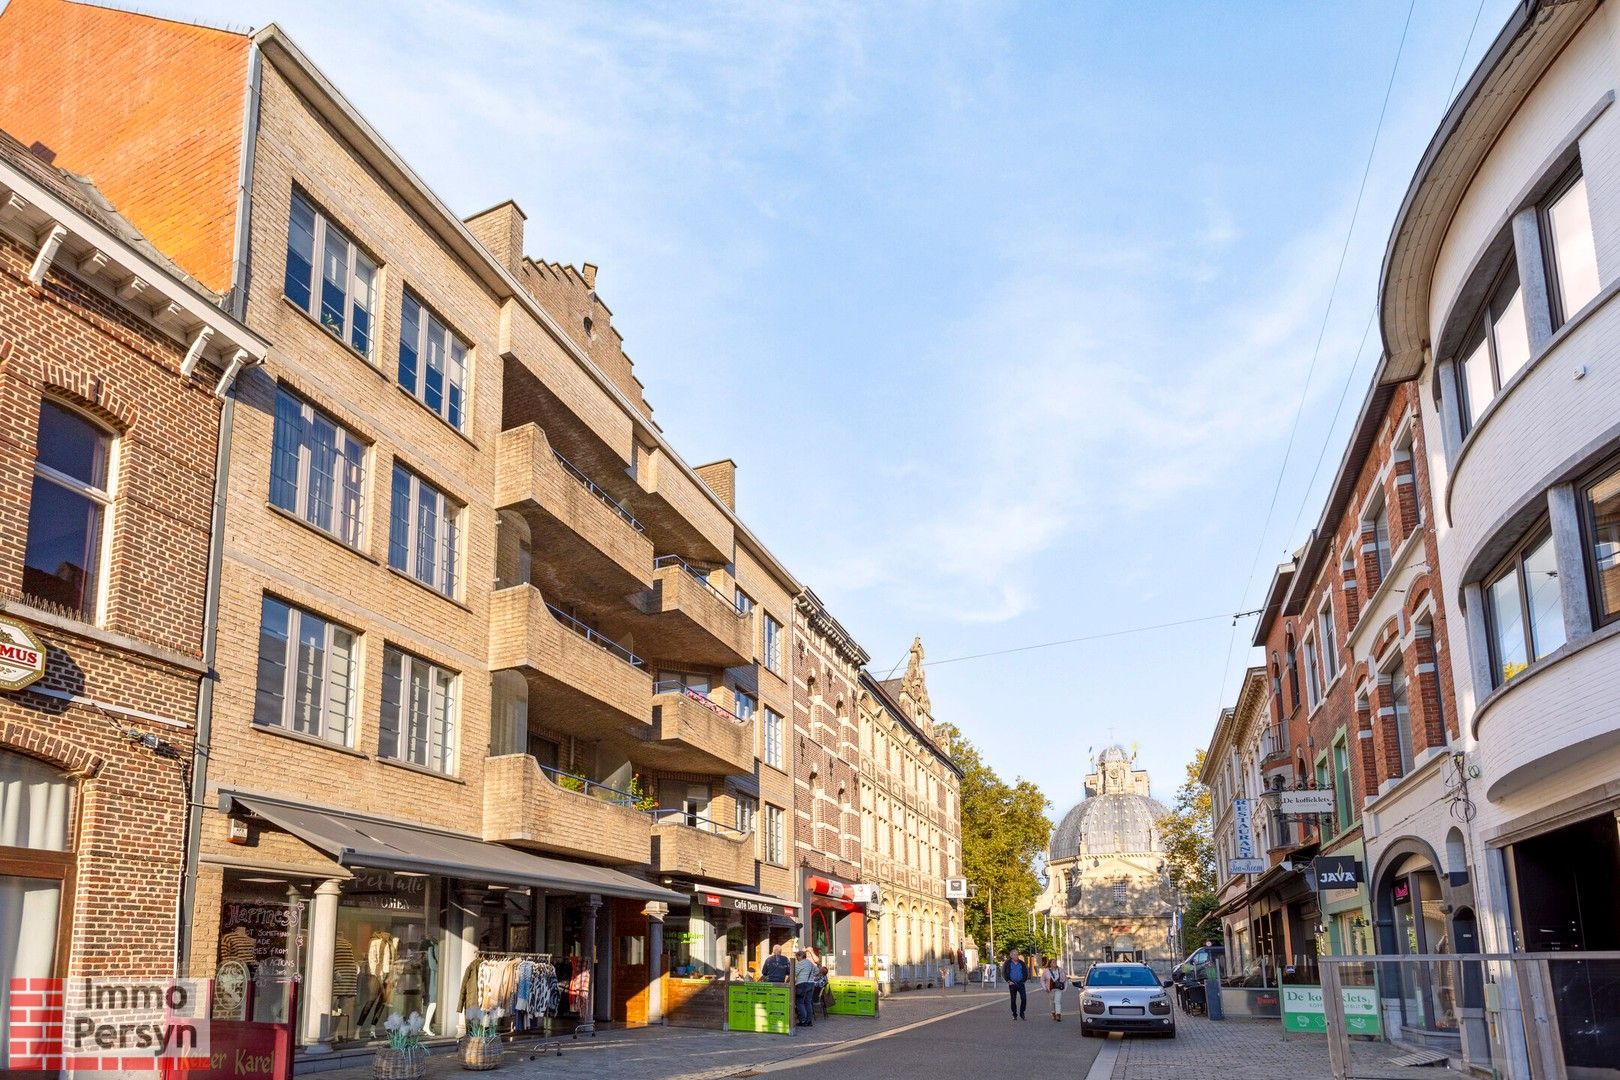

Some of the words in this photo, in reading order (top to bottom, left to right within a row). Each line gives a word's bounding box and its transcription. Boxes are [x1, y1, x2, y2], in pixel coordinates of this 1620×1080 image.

[1236, 800, 1251, 858] RESTAURANT
[1320, 872, 1355, 883] JAVA
[734, 899, 747, 909] Café
[747, 902, 758, 911] Den
[759, 904, 773, 914] Keizer
[1287, 991, 1304, 1001] De
[234, 1048, 274, 1075] Karel
